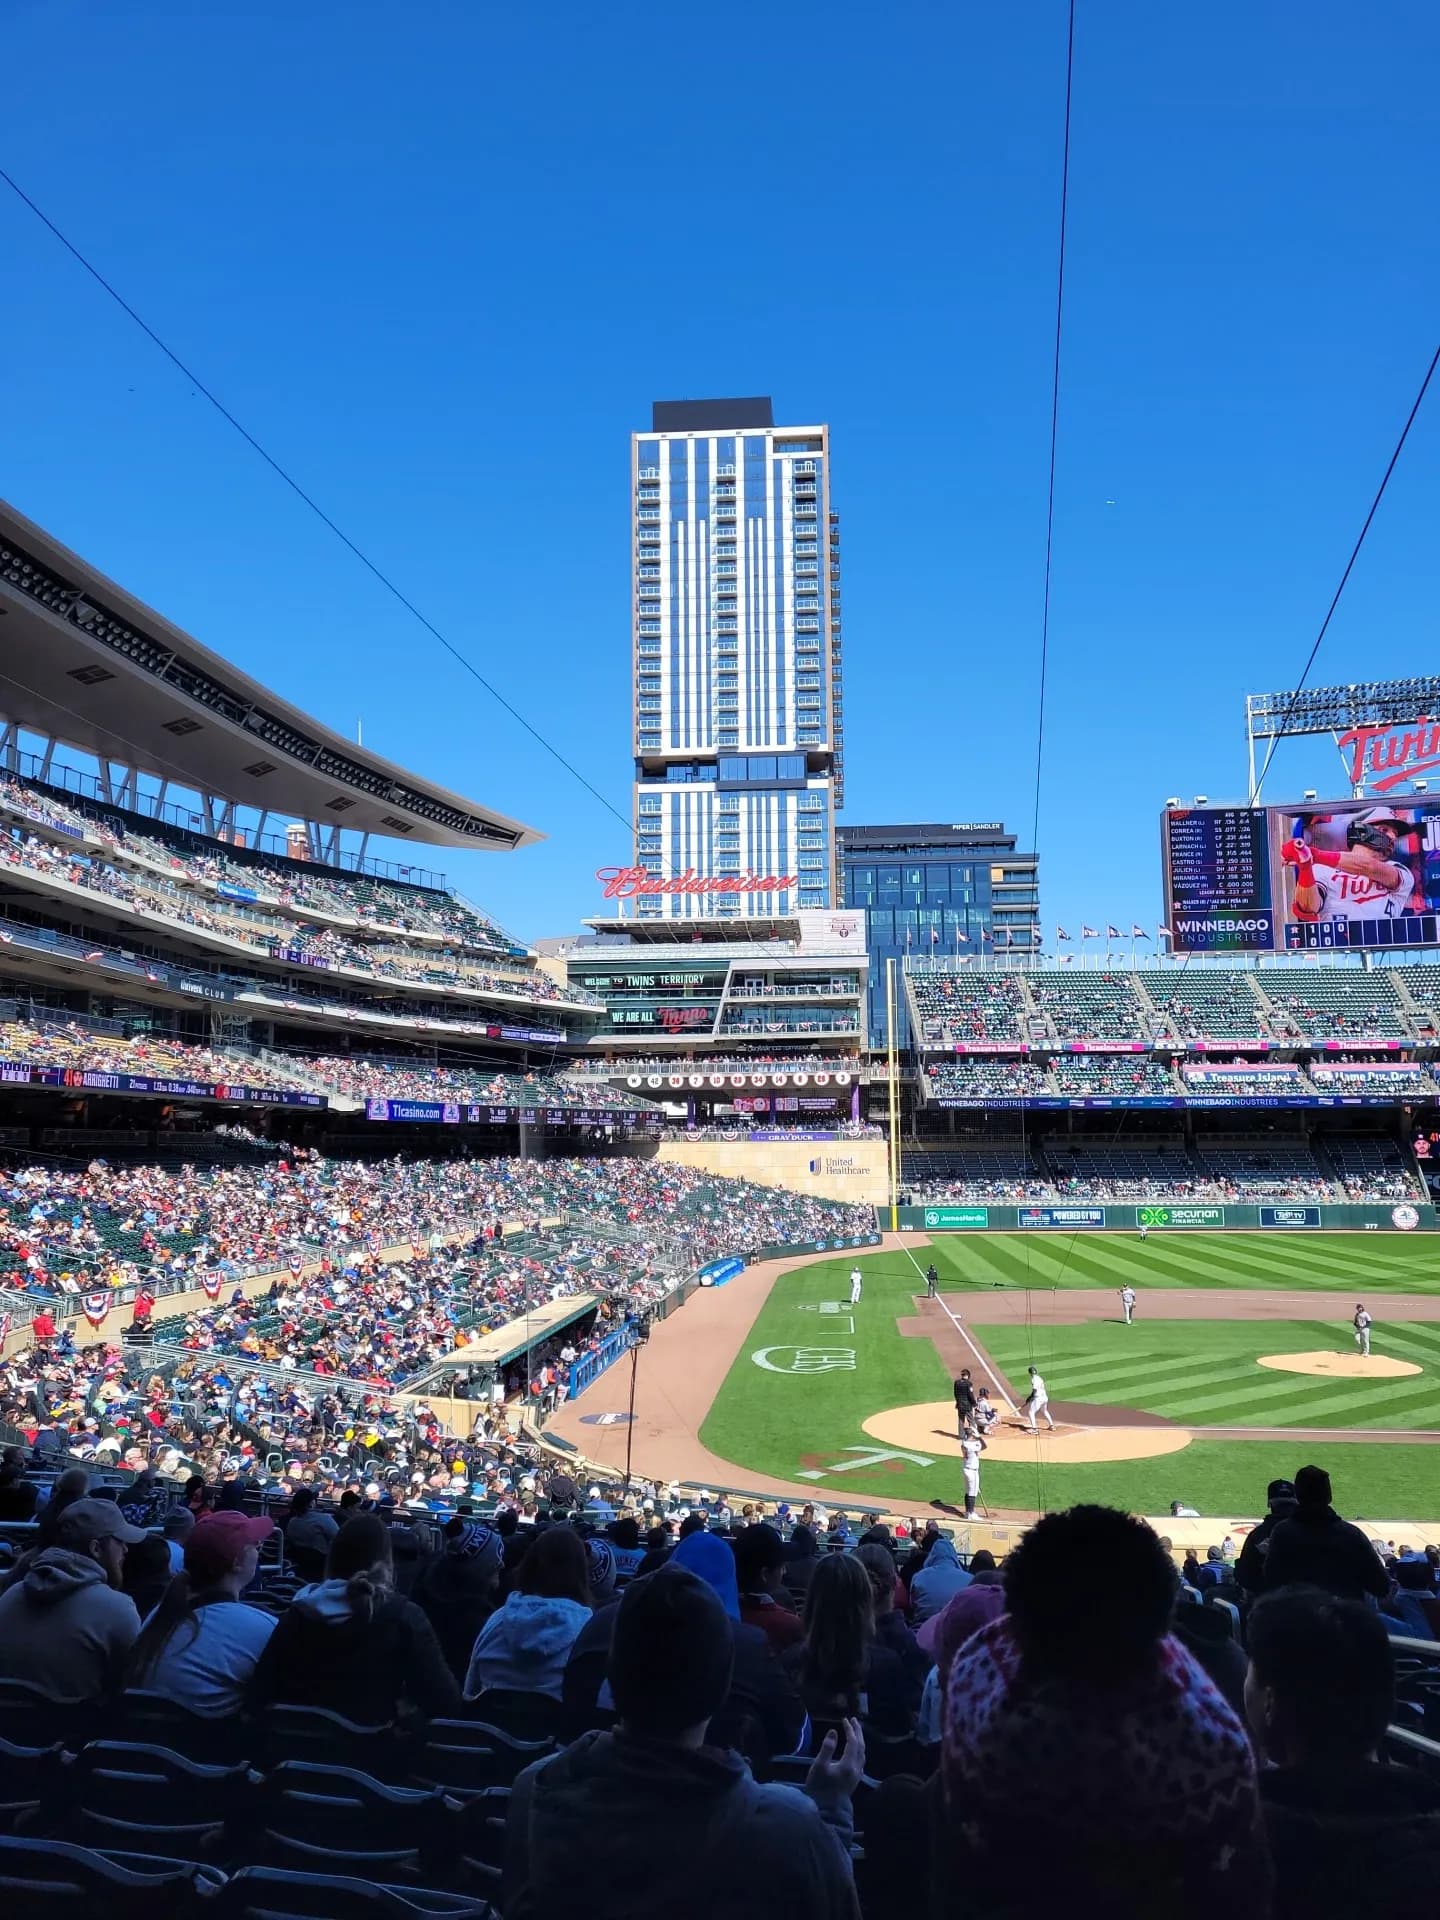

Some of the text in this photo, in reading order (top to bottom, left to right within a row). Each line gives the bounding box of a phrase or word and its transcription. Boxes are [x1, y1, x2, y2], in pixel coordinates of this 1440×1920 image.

[596, 867, 798, 899] Budweiser
[1176, 919, 1269, 932] WINNEBAGO
[1180, 932, 1268, 943] INDUSTRIES
[627, 975, 656, 987] TWINS
[660, 974, 705, 985] TERRITORY
[204, 987, 226, 1000] CLUB
[612, 1012, 625, 1023] WE
[626, 1012, 641, 1022] ARE
[642, 1011, 655, 1022] ALL
[83, 1072, 119, 1088] ARRIGHETTI
[1210, 1071, 1291, 1082] Treasure Island
[1185, 1098, 1231, 1106] WINNEBAGO
[1231, 1098, 1279, 1106] INDUSTRIES
[826, 1157, 853, 1167] United
[826, 1166, 872, 1176] Healthcare
[1053, 1210, 1081, 1221] POWERED
[1089, 1210, 1101, 1220] YOU
[1171, 1209, 1219, 1219] securian
